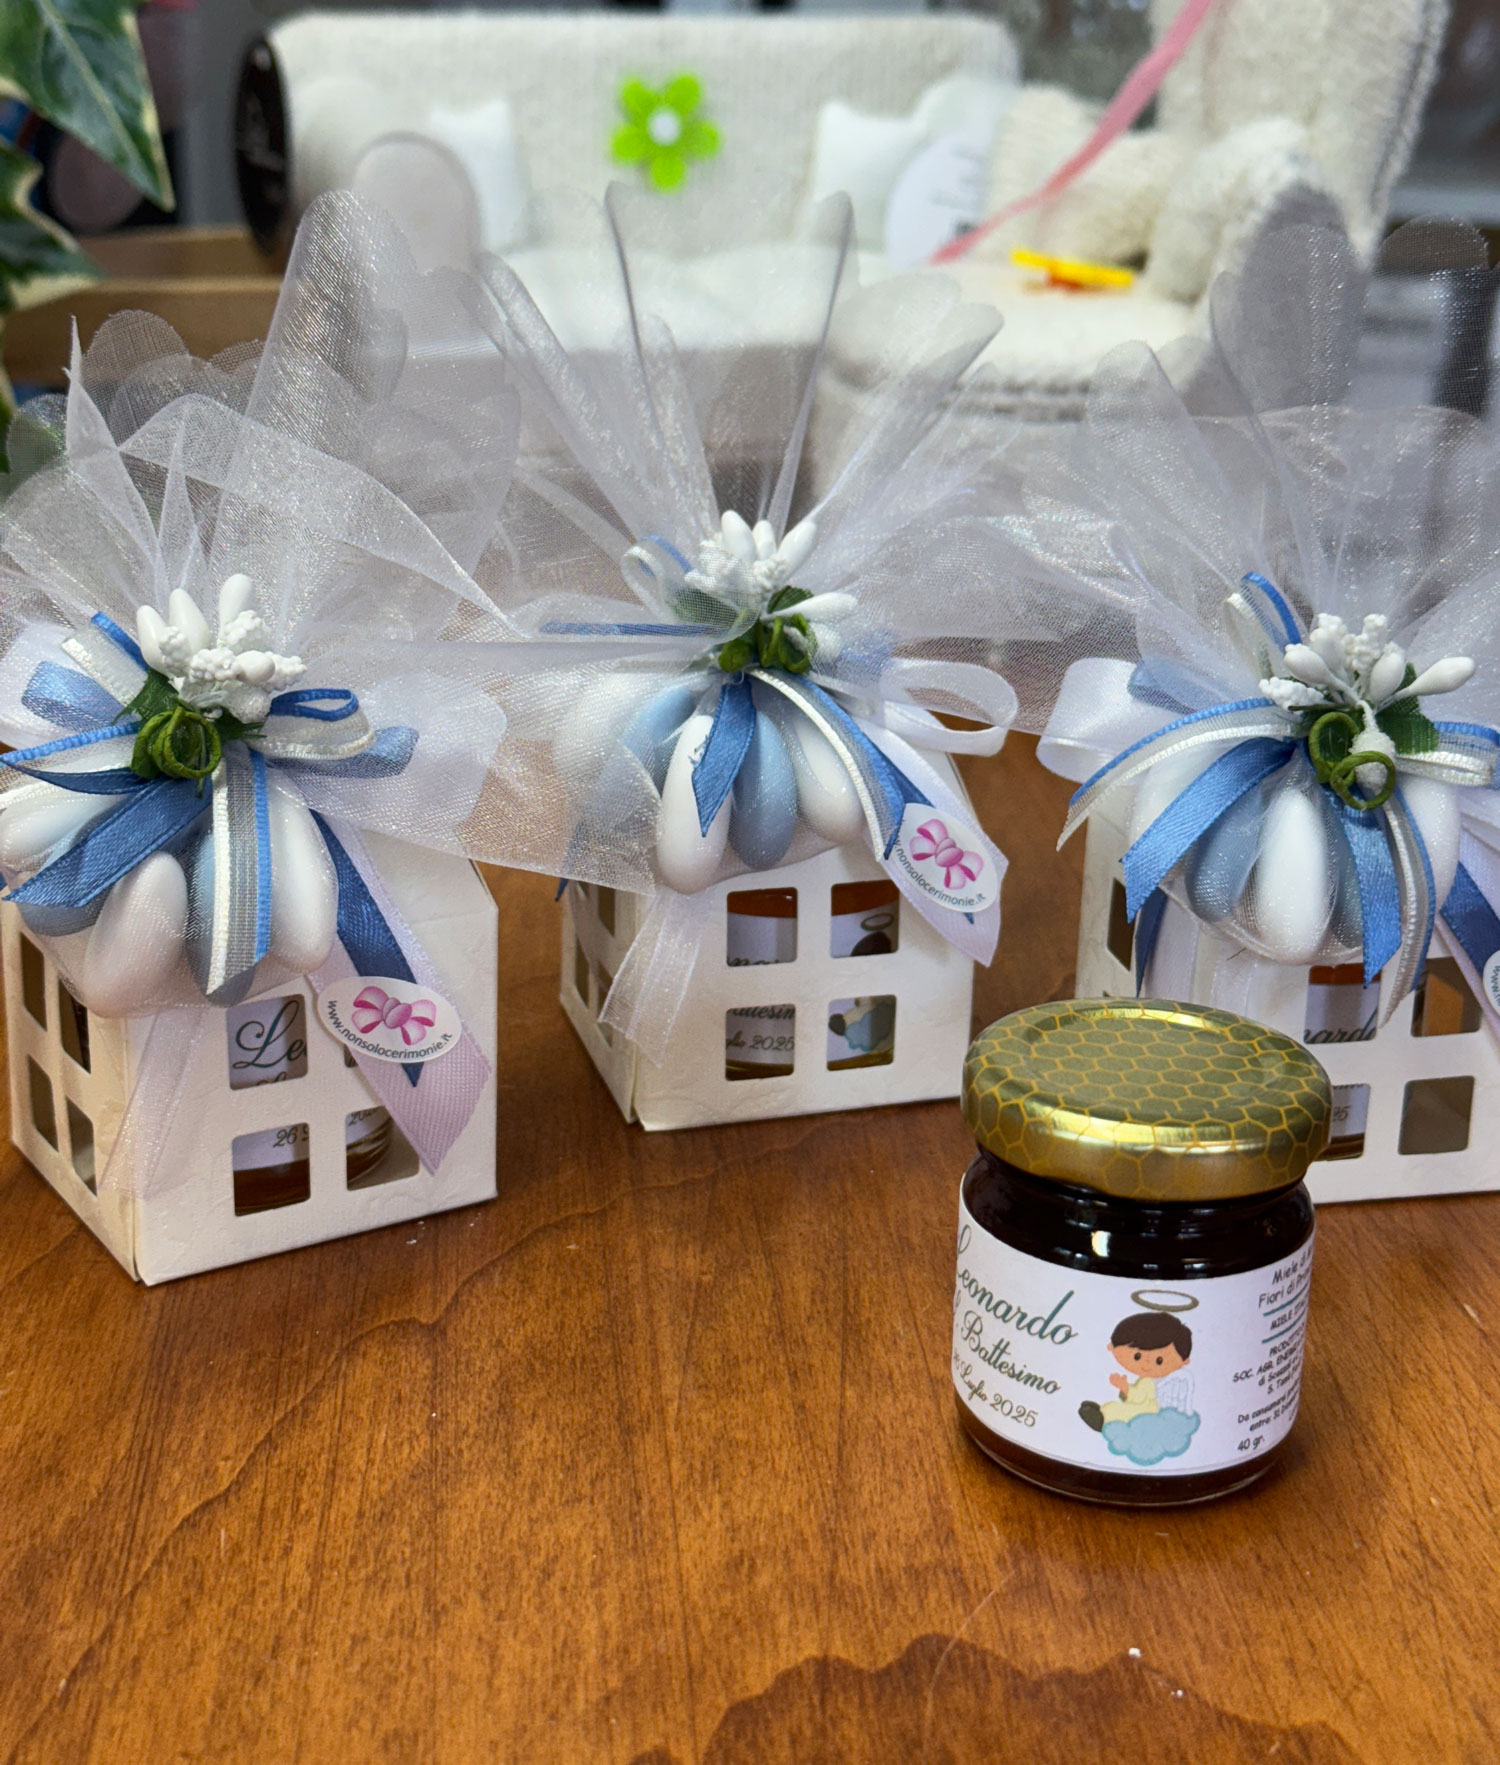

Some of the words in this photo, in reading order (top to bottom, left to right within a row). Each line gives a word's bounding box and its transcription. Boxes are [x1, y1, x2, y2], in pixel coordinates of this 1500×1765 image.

[328, 1000, 452, 1059] www.nonsolocerimonie.it
[273, 1129, 298, 1148] 26
[1259, 1285, 1284, 1308] Fiori
[961, 1310, 1061, 1395] Battesimo
[989, 1392, 1039, 1428] 2025
[1237, 1438, 1251, 1452] 40
